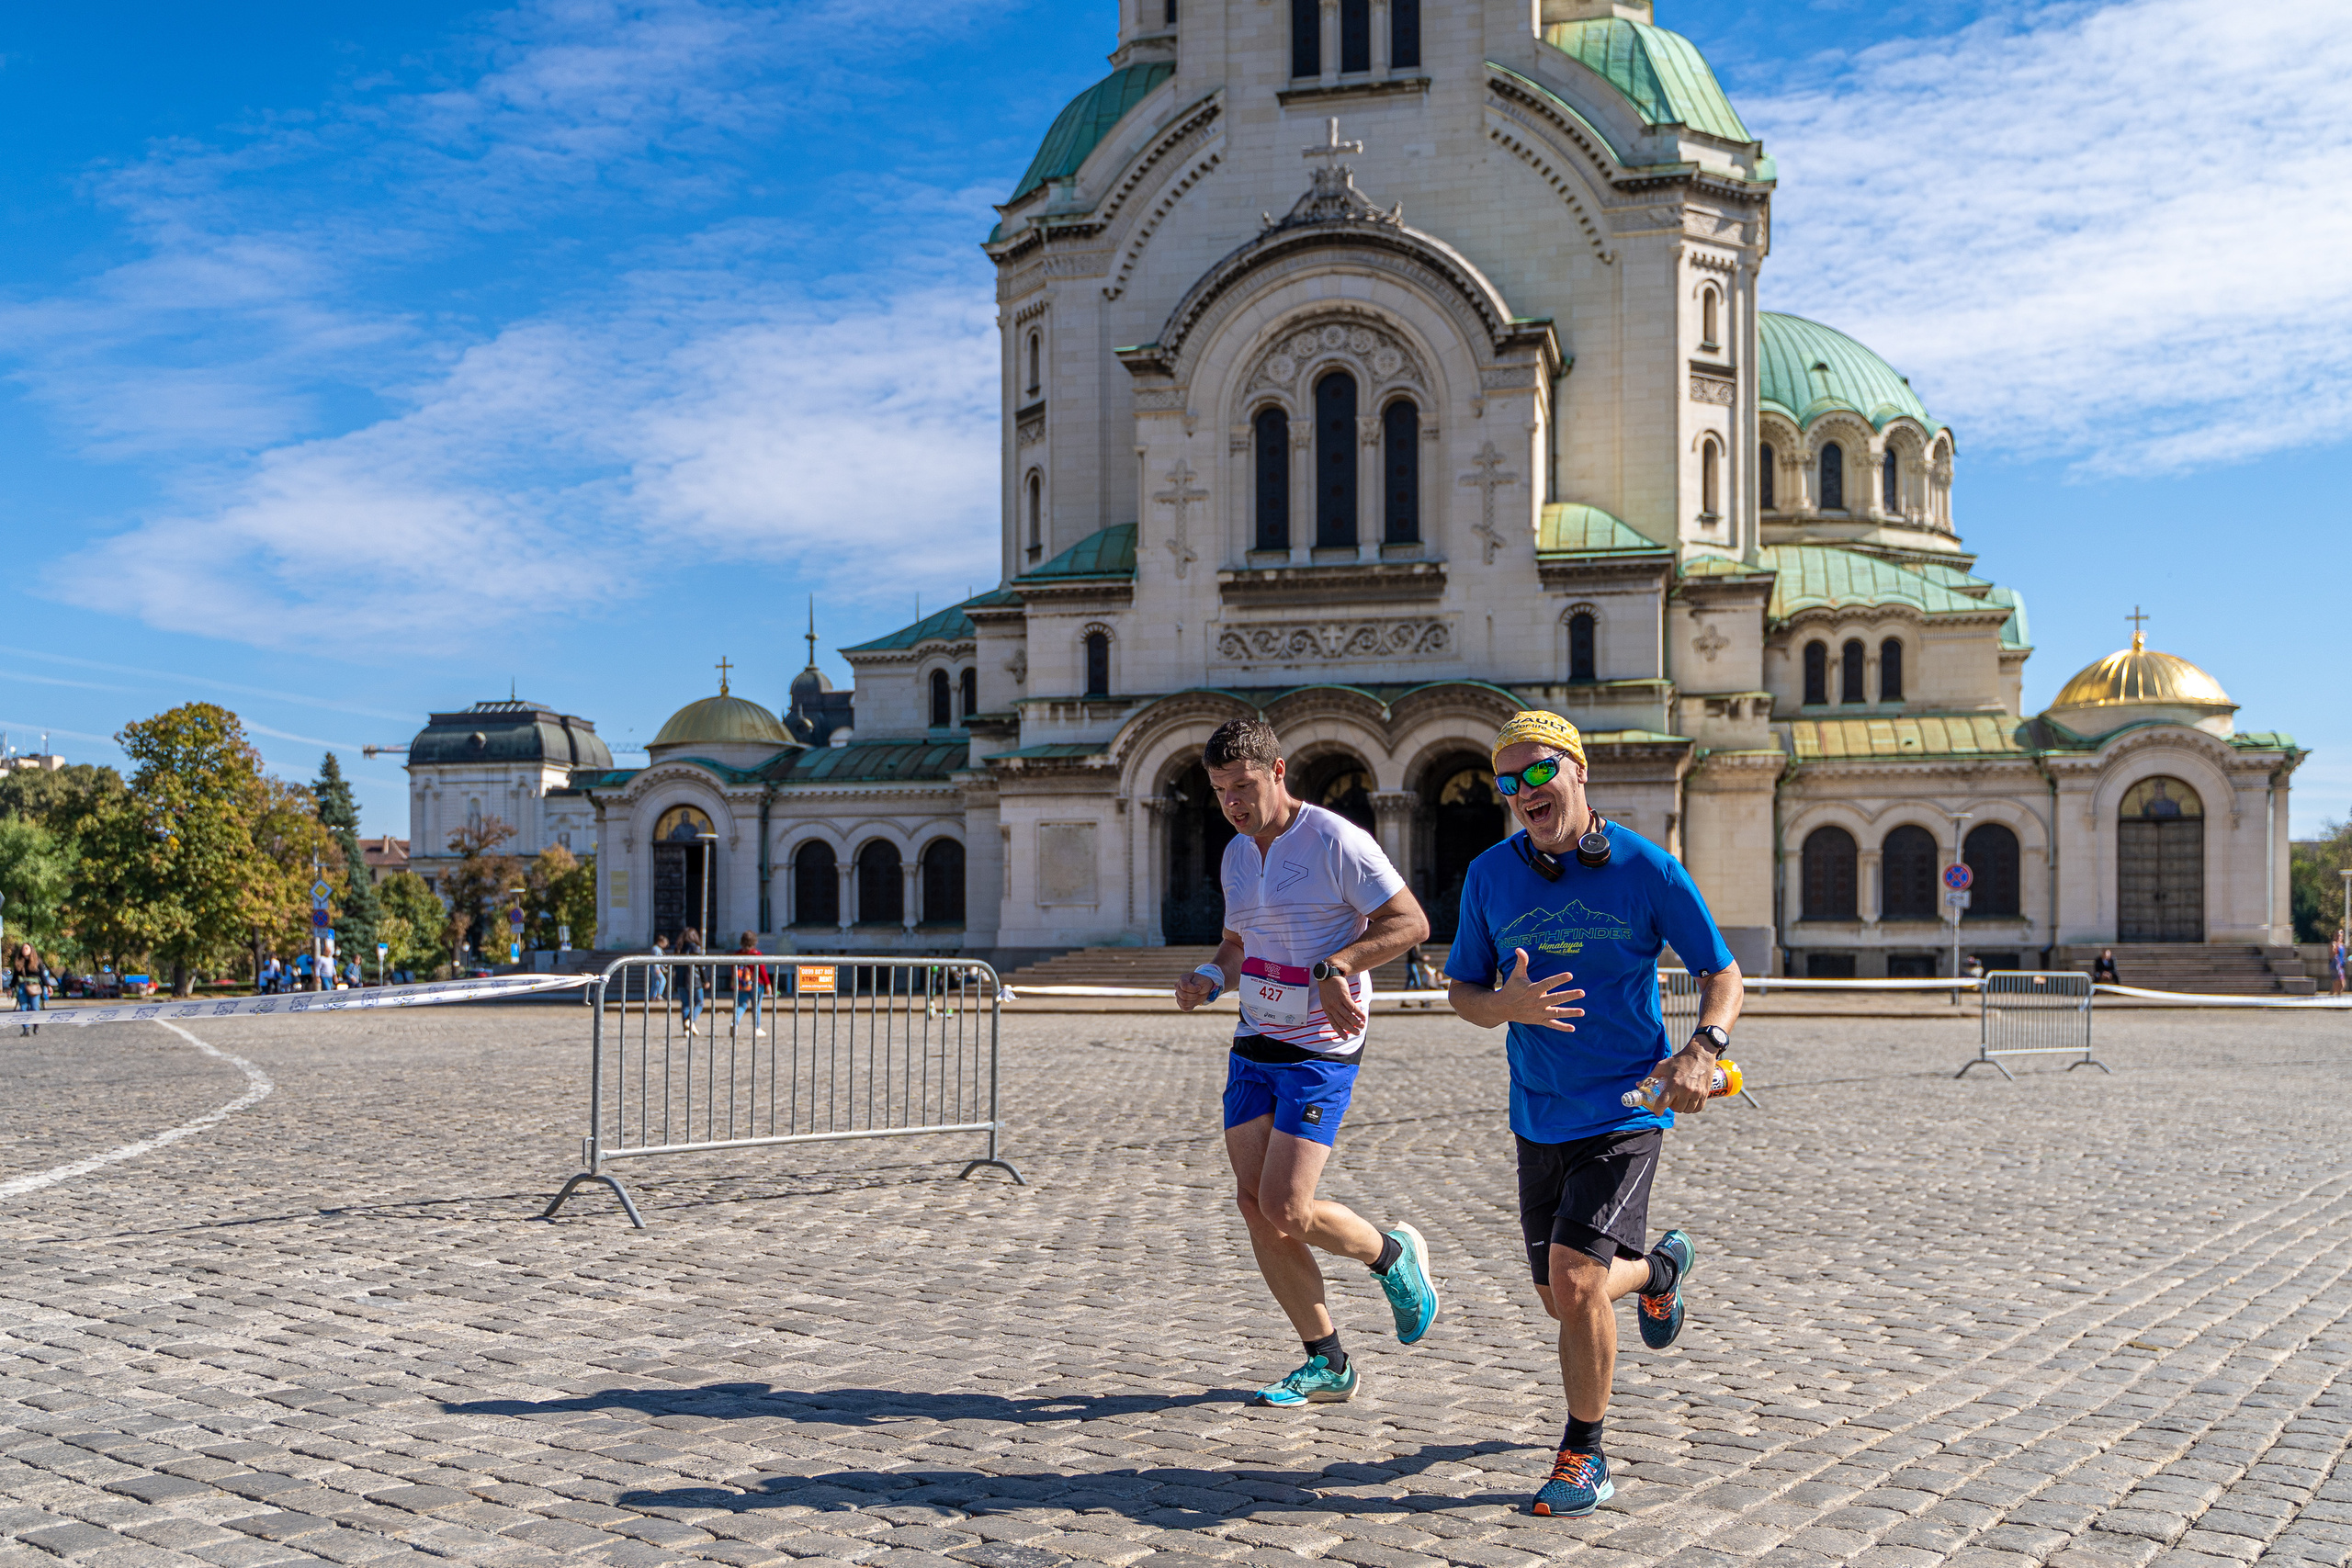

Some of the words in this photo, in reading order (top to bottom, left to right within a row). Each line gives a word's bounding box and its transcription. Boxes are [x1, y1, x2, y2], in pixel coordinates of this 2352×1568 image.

[1498, 927, 1634, 949] NORTHFINDER
[1538, 941, 1584, 953] Himalayas
[1259, 986, 1283, 1001] 427
